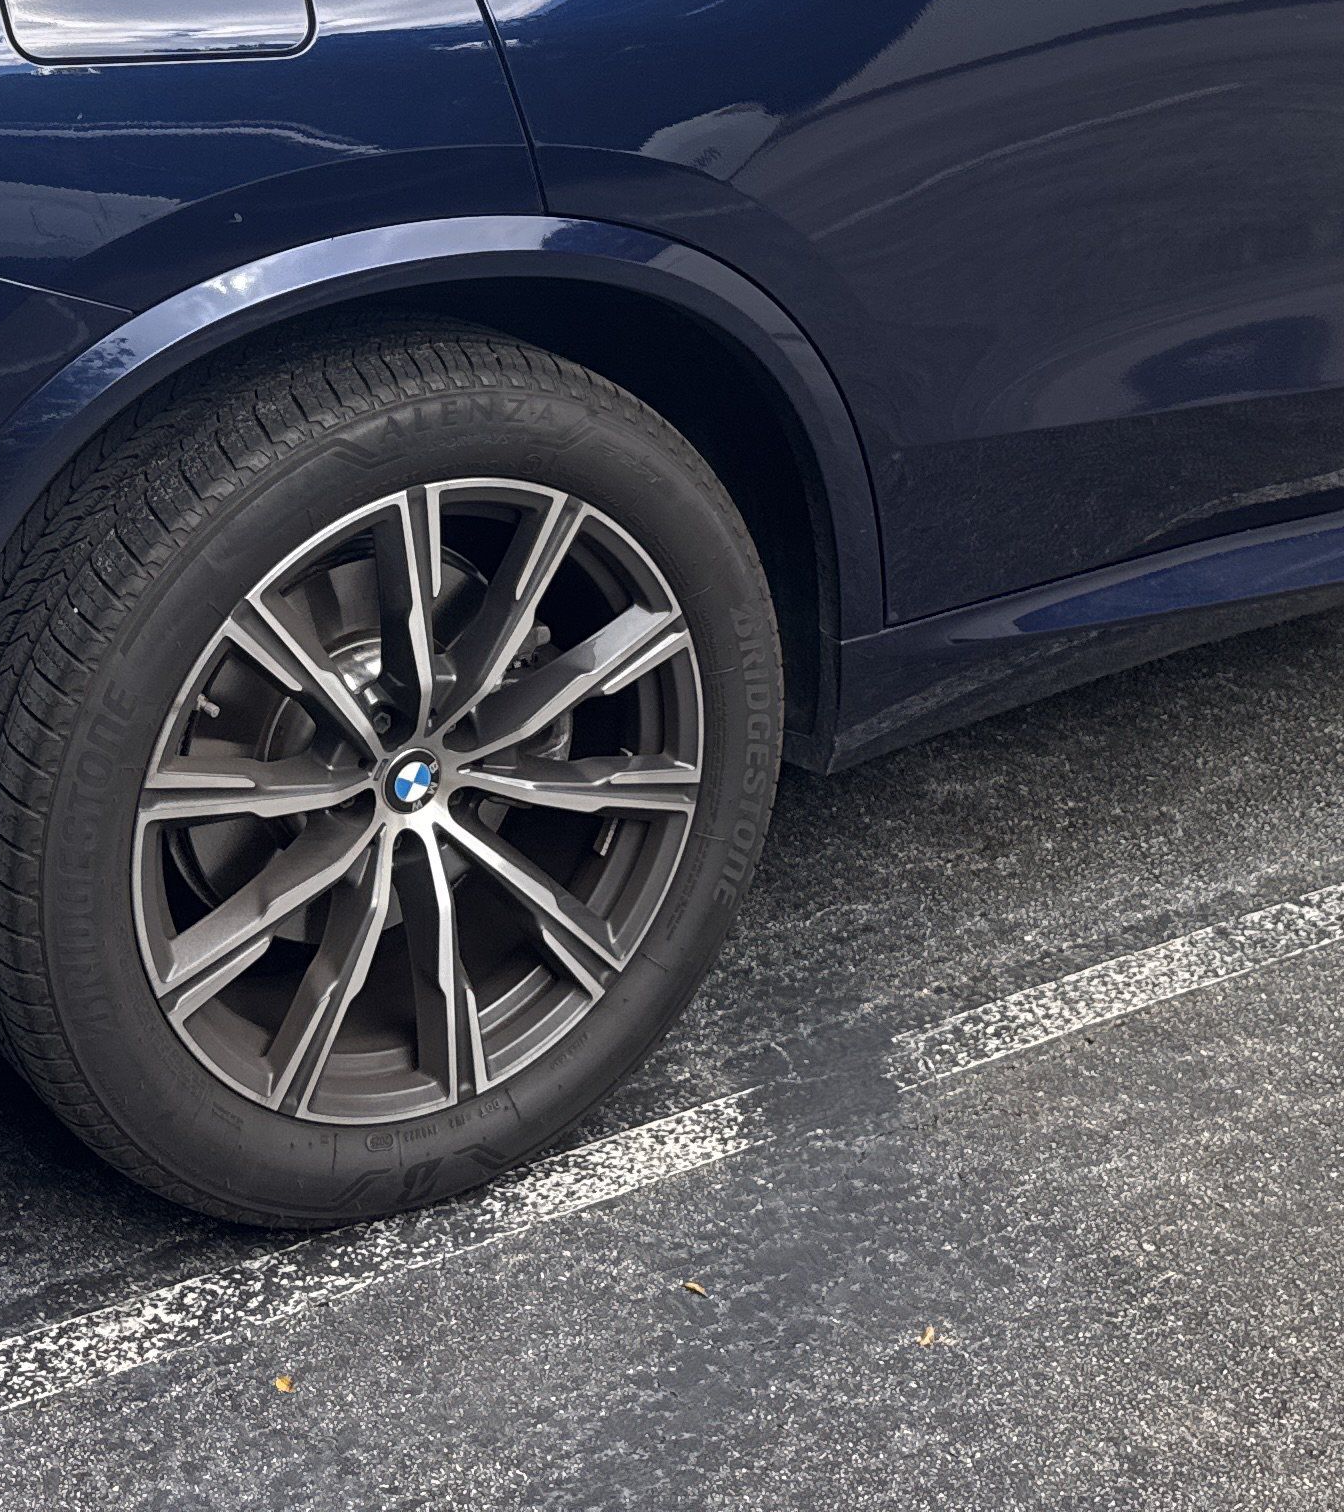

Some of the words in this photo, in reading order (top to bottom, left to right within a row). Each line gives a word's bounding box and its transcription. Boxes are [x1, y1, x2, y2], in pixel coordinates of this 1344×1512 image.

[383, 397, 556, 434] ALENZA
[713, 603, 772, 910] BRIDGESTONE
[411, 760, 439, 813] BMW
